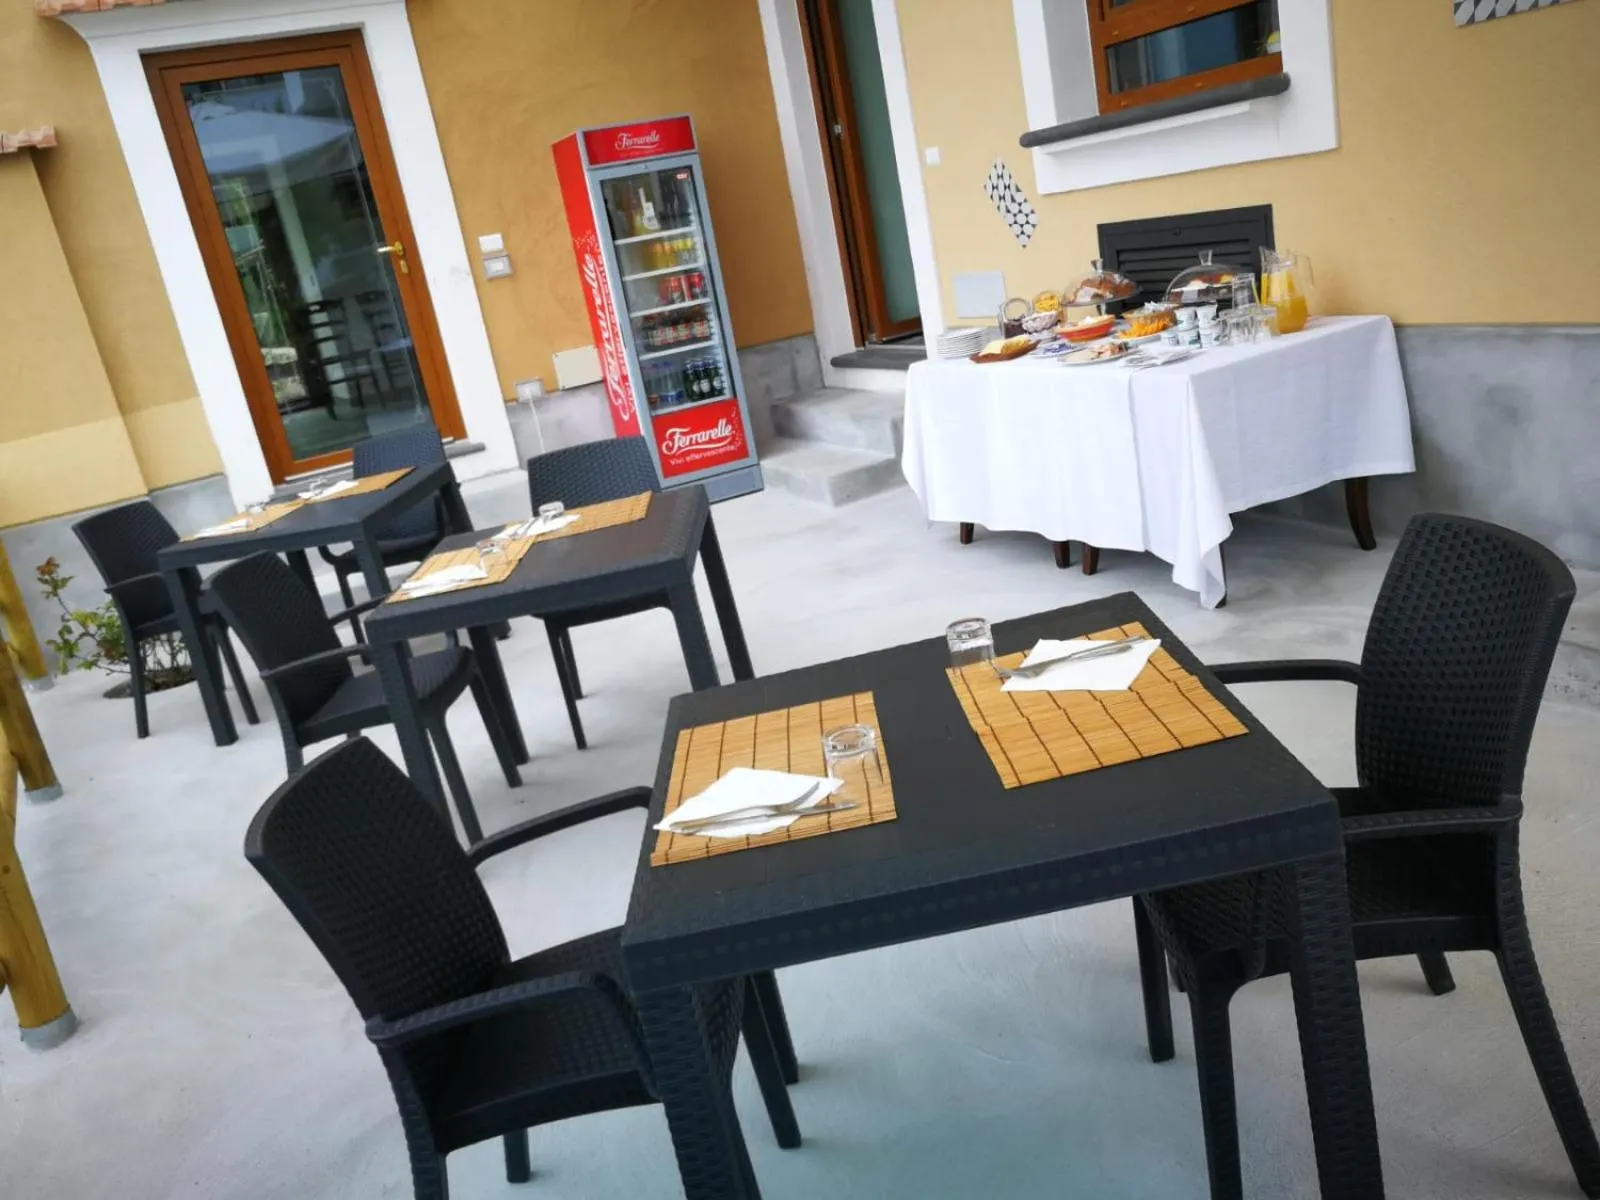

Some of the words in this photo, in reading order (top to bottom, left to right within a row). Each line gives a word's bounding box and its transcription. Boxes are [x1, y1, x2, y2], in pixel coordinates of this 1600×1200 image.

[615, 130, 660, 150] Ferrarelle
[582, 253, 630, 421] Ferrarelle
[662, 418, 733, 455] Ferrarelle
